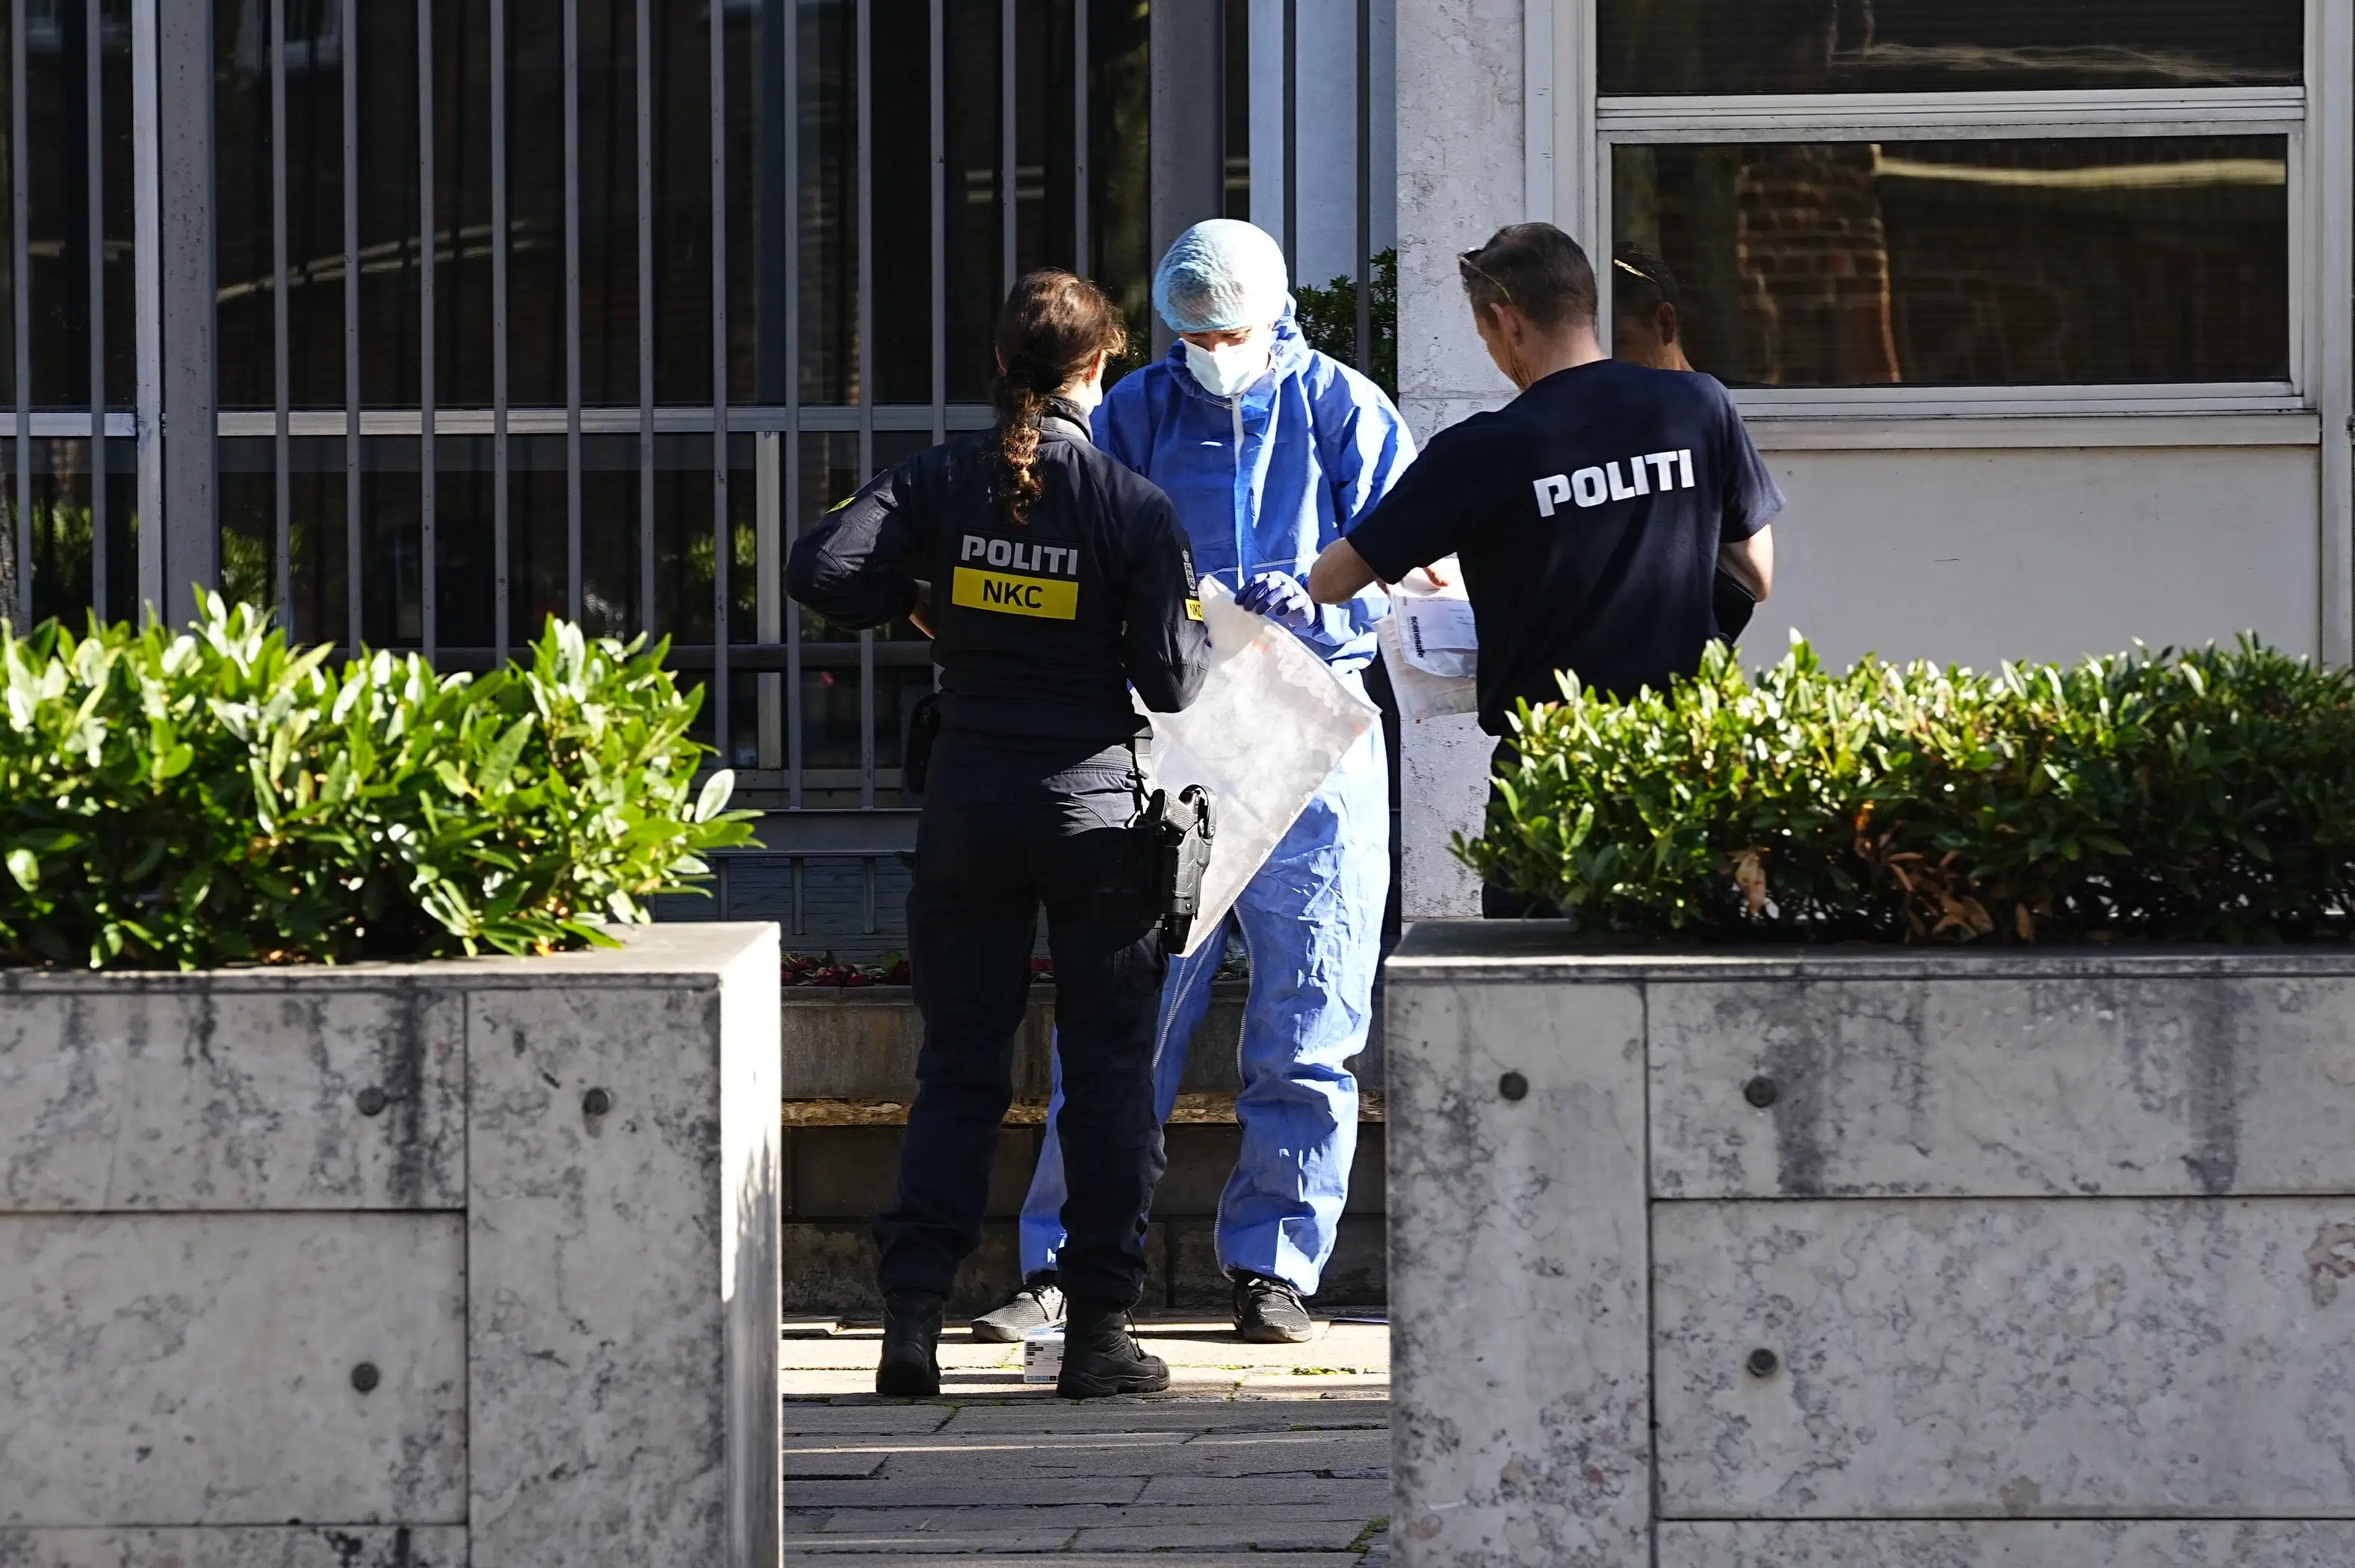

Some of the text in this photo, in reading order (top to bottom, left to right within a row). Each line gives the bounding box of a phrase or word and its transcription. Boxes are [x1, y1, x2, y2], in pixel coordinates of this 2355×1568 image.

[1532, 449, 1695, 518] POLITI
[961, 534, 1078, 575] POLITI
[982, 579, 1044, 609] NKC
